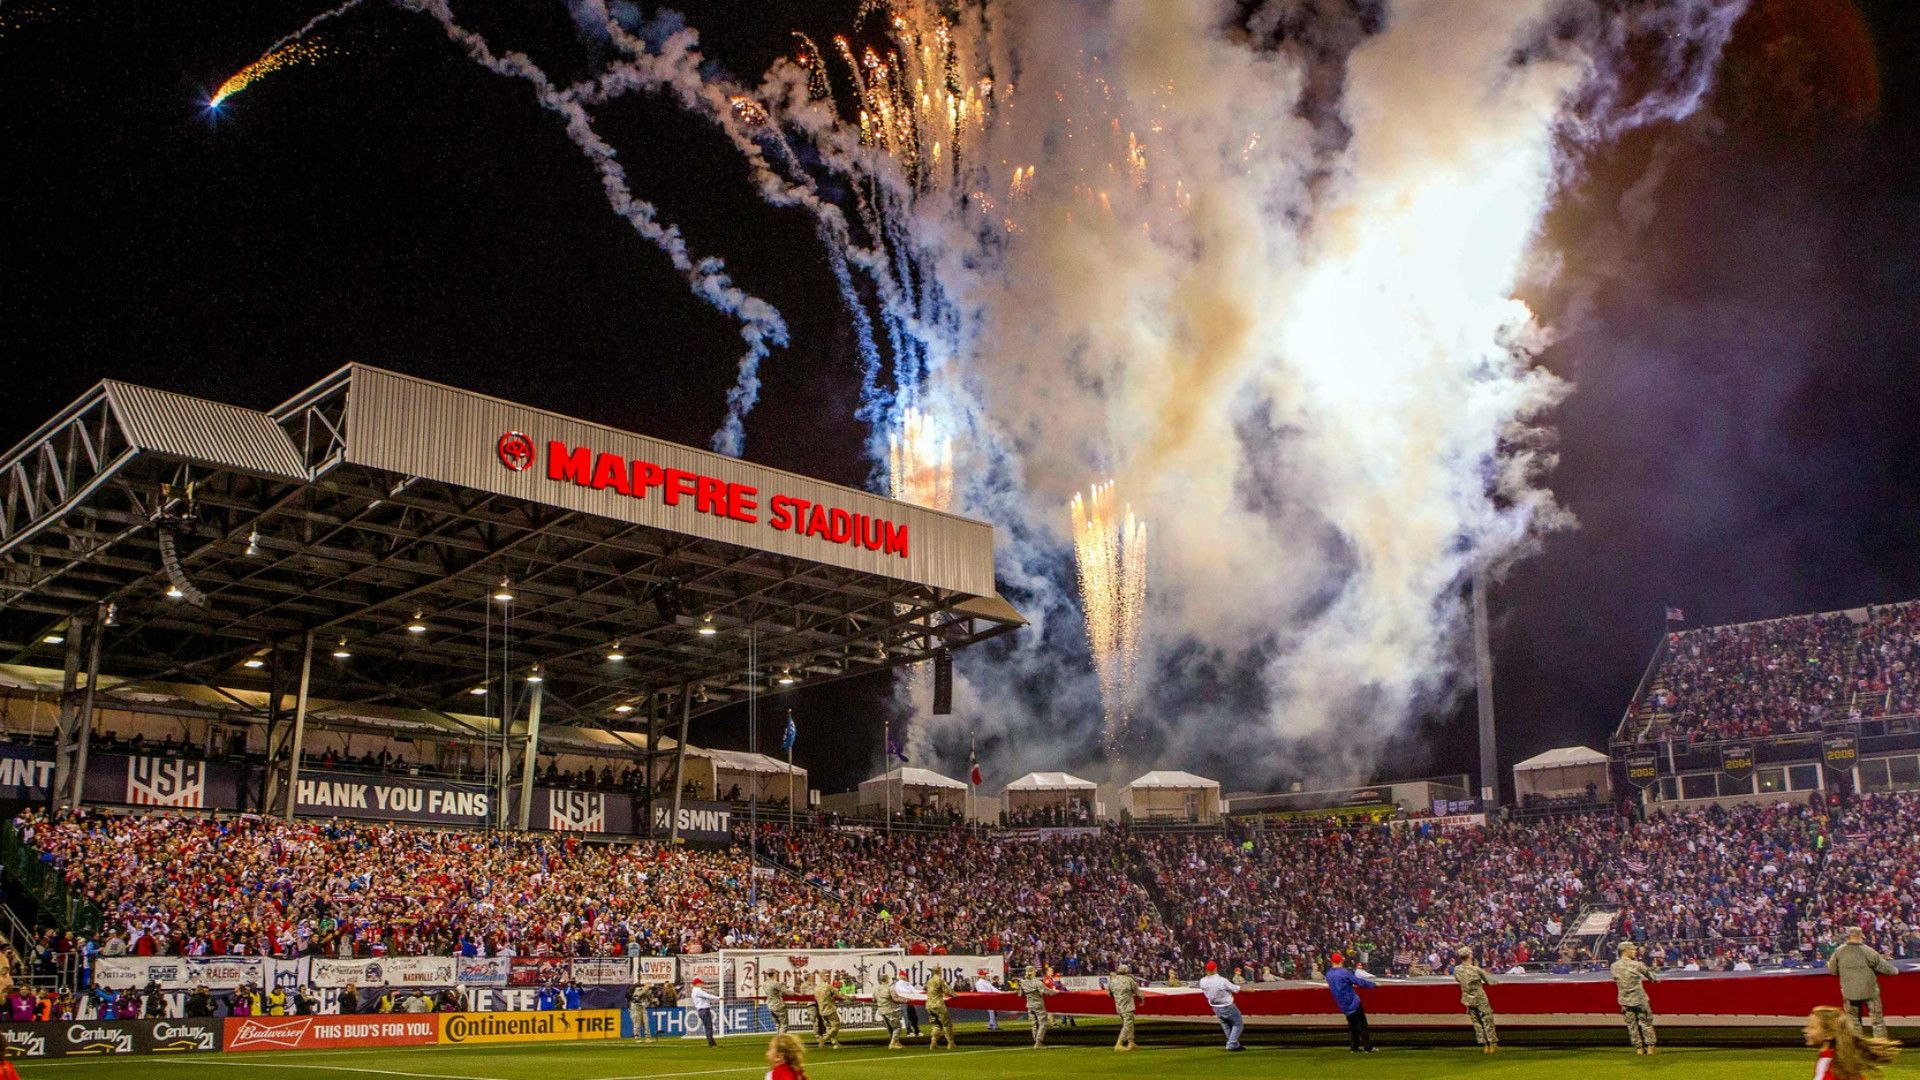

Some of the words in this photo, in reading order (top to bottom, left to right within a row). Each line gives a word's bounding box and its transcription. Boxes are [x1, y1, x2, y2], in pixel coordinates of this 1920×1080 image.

[549, 440, 758, 523] MAPFRE
[771, 495, 909, 558] STADIUM
[133, 756, 201, 797] USA
[281, 779, 368, 809] HANK
[374, 785, 423, 812] YOU
[429, 790, 489, 817] FANS
[553, 790, 601, 824] USA
[207, 968, 240, 978] RALEIGH
[877, 960, 963, 988] Otlws
[445, 1014, 554, 1043] Continental
[575, 1017, 615, 1032] TIRE
[836, 1006, 872, 1023] SOCCER
[0, 1029, 35, 1045] ntury
[26, 1037, 45, 1056] 21
[67, 1024, 122, 1043] Century
[115, 1035, 133, 1052] 21
[153, 1022, 205, 1041] Century
[198, 1032, 214, 1049] 21
[238, 1025, 303, 1040] Budweiser
[313, 1025, 341, 1039] THIS
[344, 1024, 379, 1038] BUD'S
[382, 1023, 404, 1037] FOR
[407, 1022, 433, 1036] YOU.
